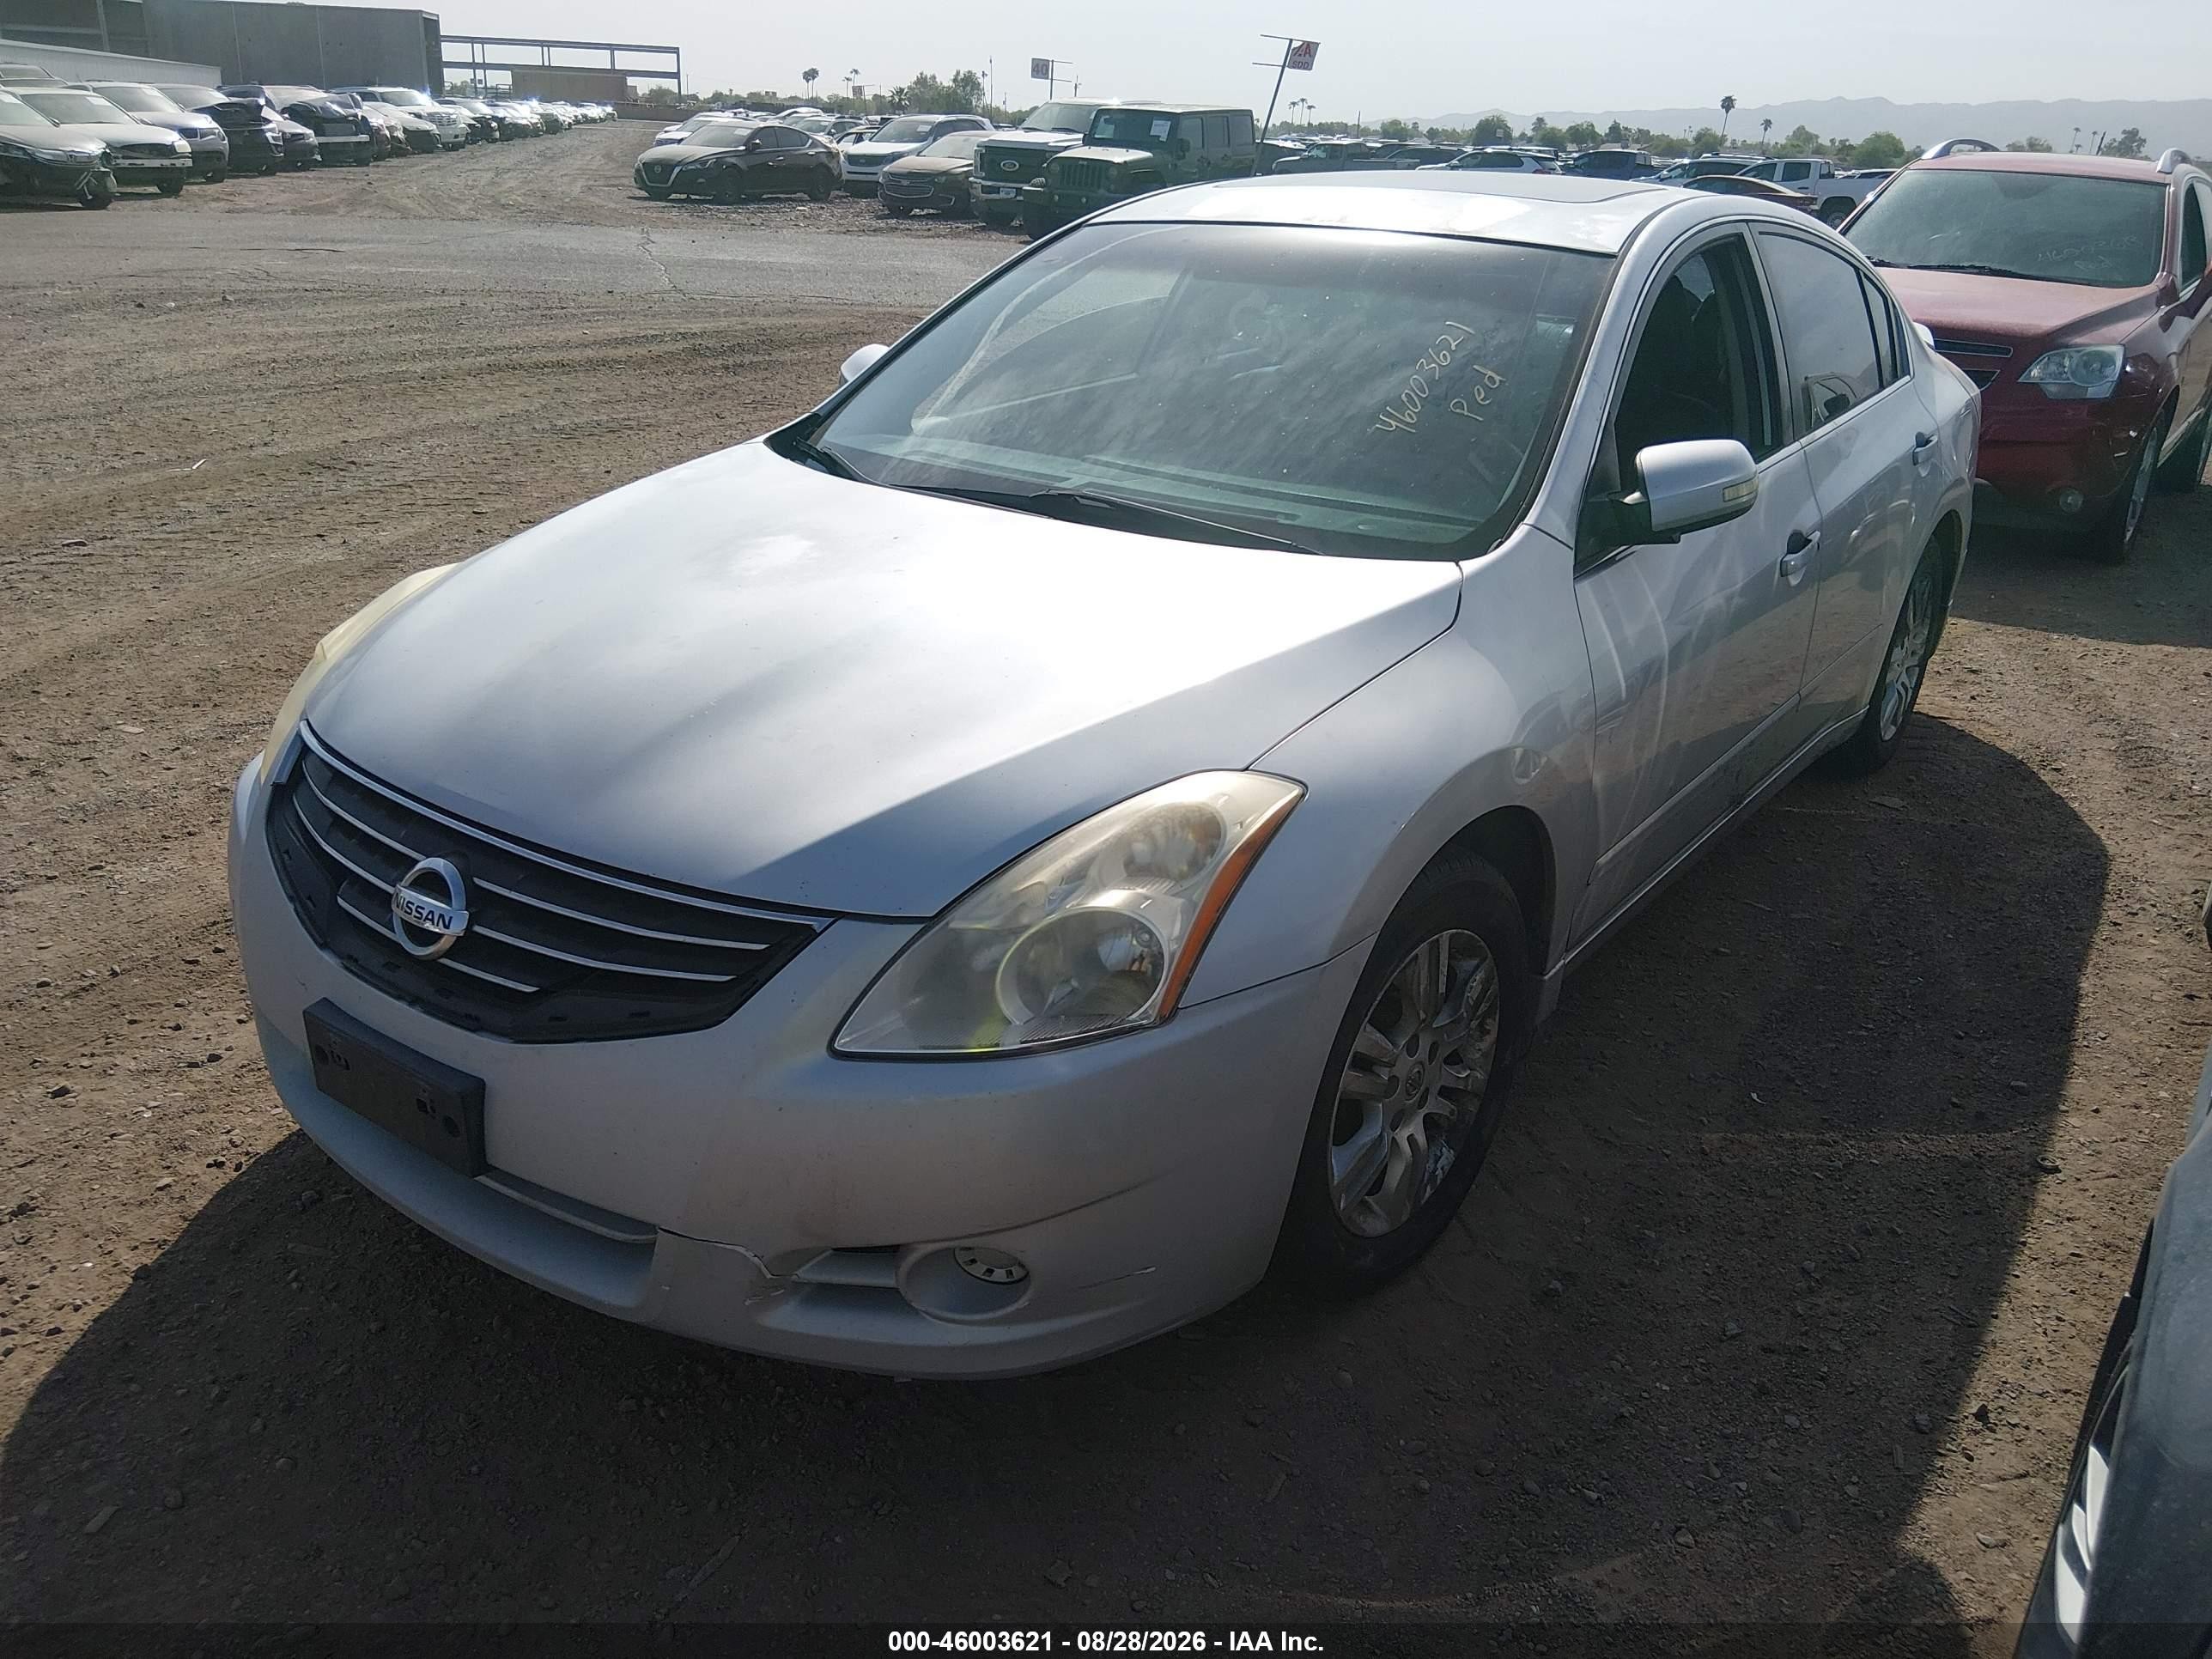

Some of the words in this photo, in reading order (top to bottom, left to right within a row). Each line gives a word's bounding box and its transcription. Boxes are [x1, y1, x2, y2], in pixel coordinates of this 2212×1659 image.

[1032, 63, 1049, 76] 40
[1374, 321, 1476, 433] 46003621
[1449, 365, 1506, 421] Ped
[395, 891, 453, 930] NISSAN
